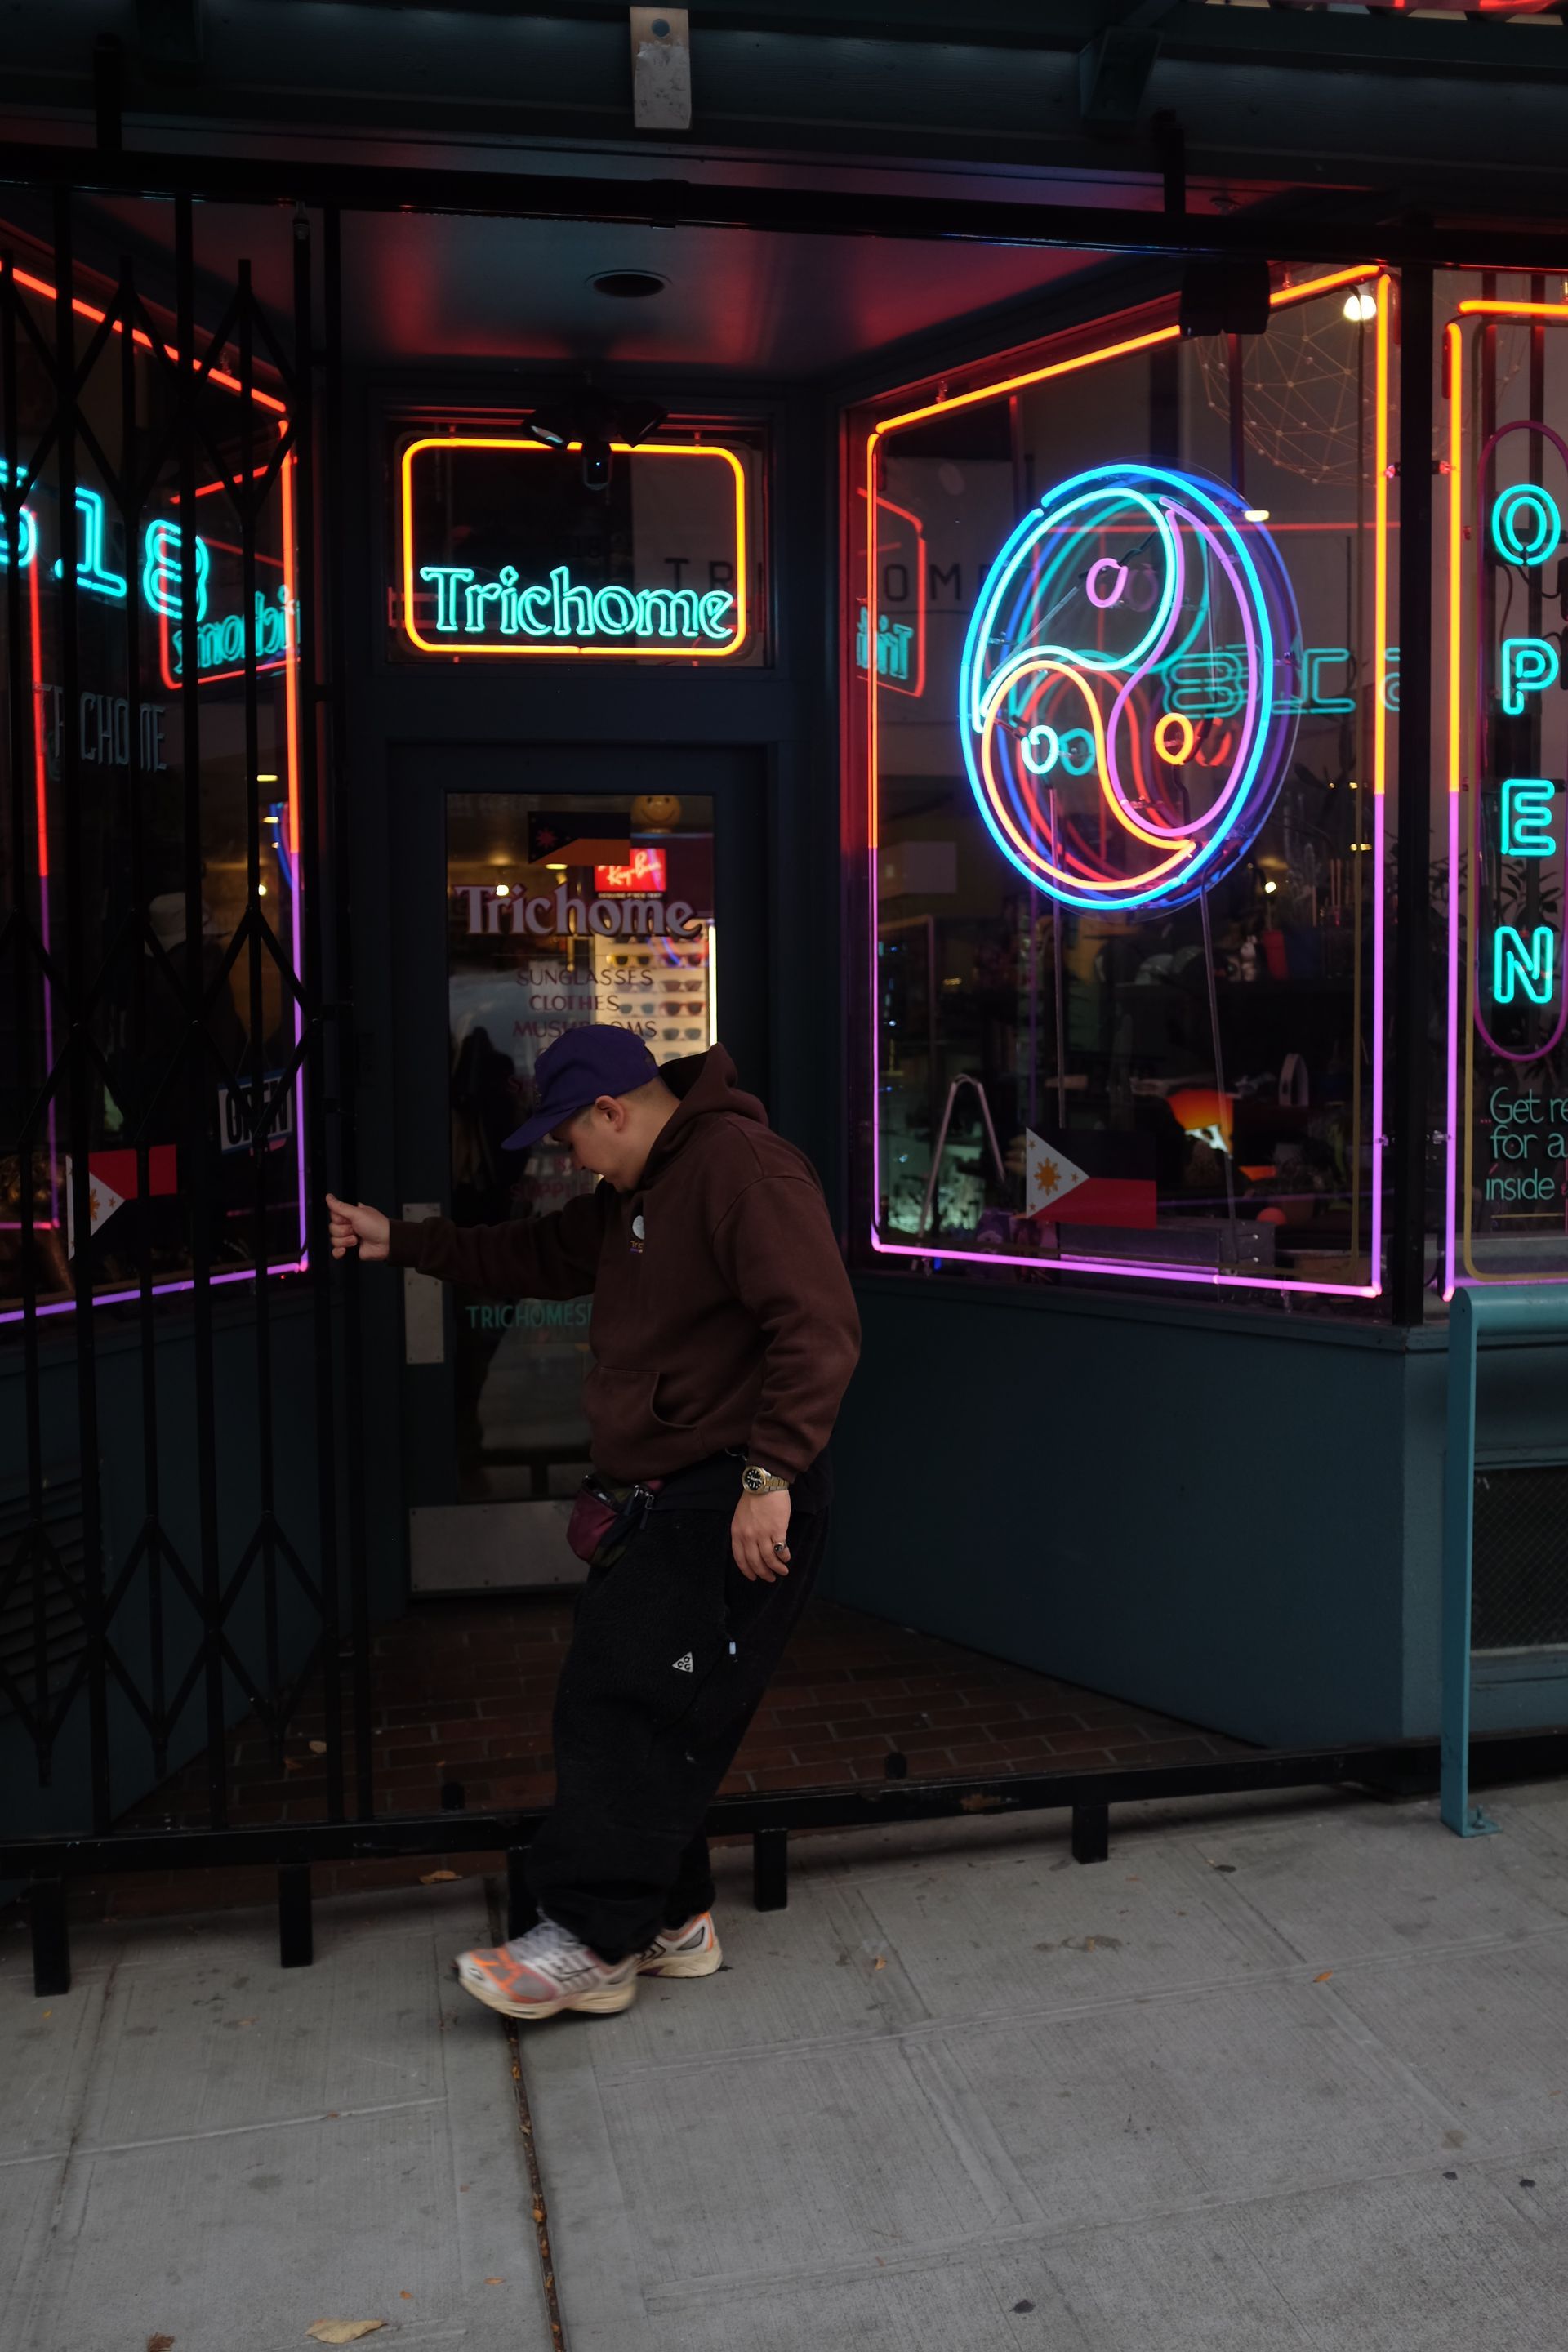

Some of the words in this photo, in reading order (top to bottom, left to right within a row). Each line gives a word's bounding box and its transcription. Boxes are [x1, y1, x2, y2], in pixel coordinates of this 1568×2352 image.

[419, 565, 734, 639] Trichome
[1491, 483, 1561, 1004] OPEN
[453, 882, 702, 938] Trichome
[516, 969, 653, 986] SUNGLASSES
[529, 995, 620, 1012] CLOTHES
[1490, 1086, 1544, 1124] Get
[1490, 1124, 1539, 1160] for
[1486, 1167, 1556, 1201] inside
